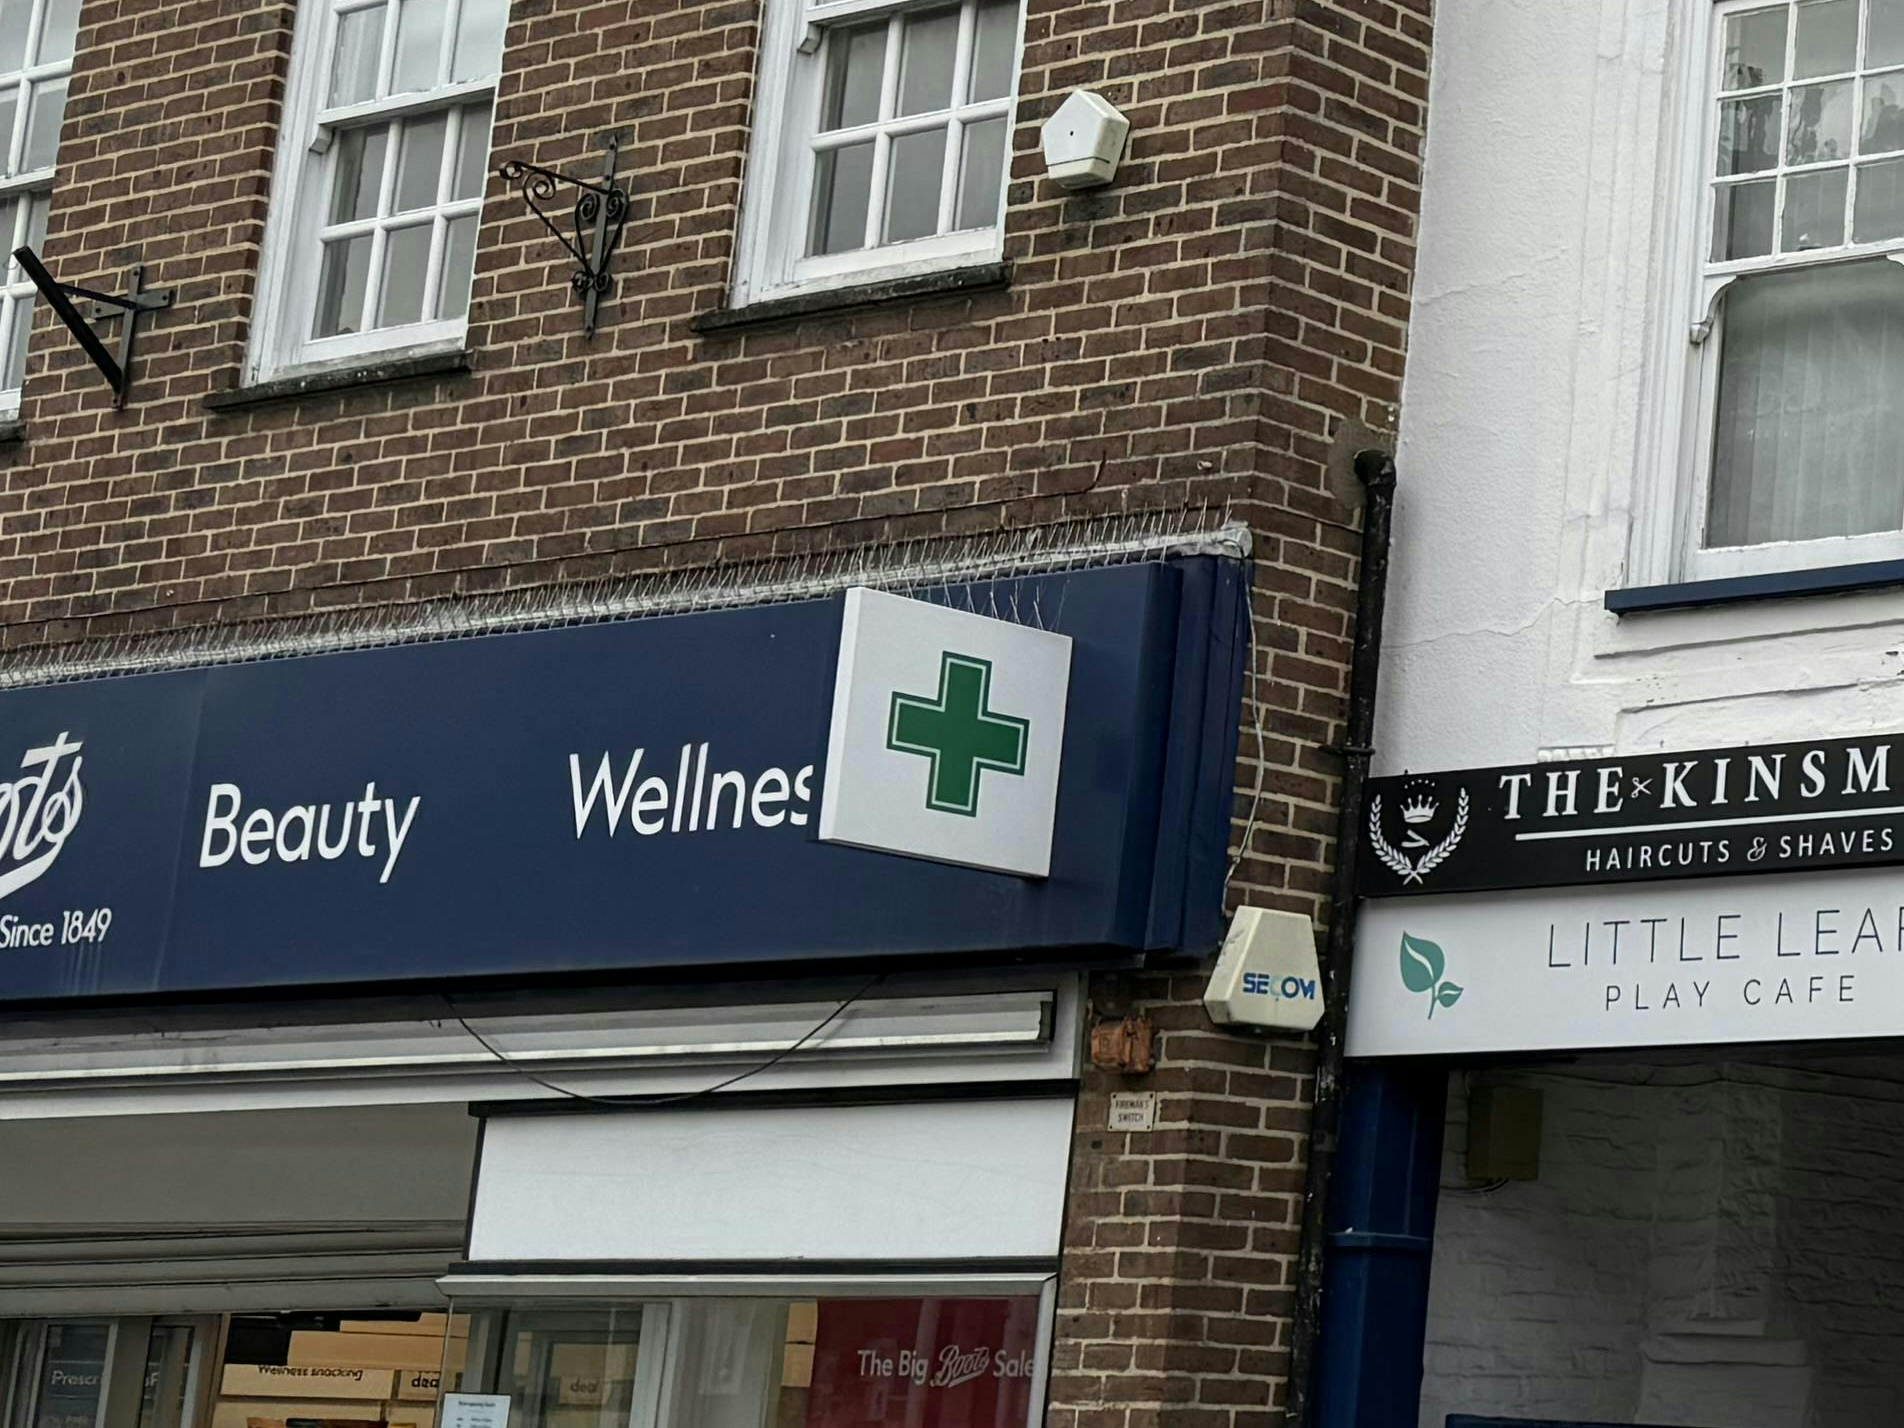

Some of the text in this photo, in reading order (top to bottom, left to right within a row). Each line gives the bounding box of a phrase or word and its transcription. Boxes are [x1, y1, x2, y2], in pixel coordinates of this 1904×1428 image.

[569, 742, 813, 839] Wellnes
[1499, 766, 1624, 820] THE
[199, 781, 421, 883] Beauty
[1585, 827, 1895, 871] HAIRCUTS & SHAVES
[0, 908, 112, 948] Since 1849
[1548, 914, 1742, 968] LITTLE
[1243, 972, 1317, 1000] SECOM
[1605, 975, 1855, 1011] PLAY CAFE
[51, 1371, 99, 1387] Prescr
[858, 1345, 1034, 1388] The Big Boots Sale
